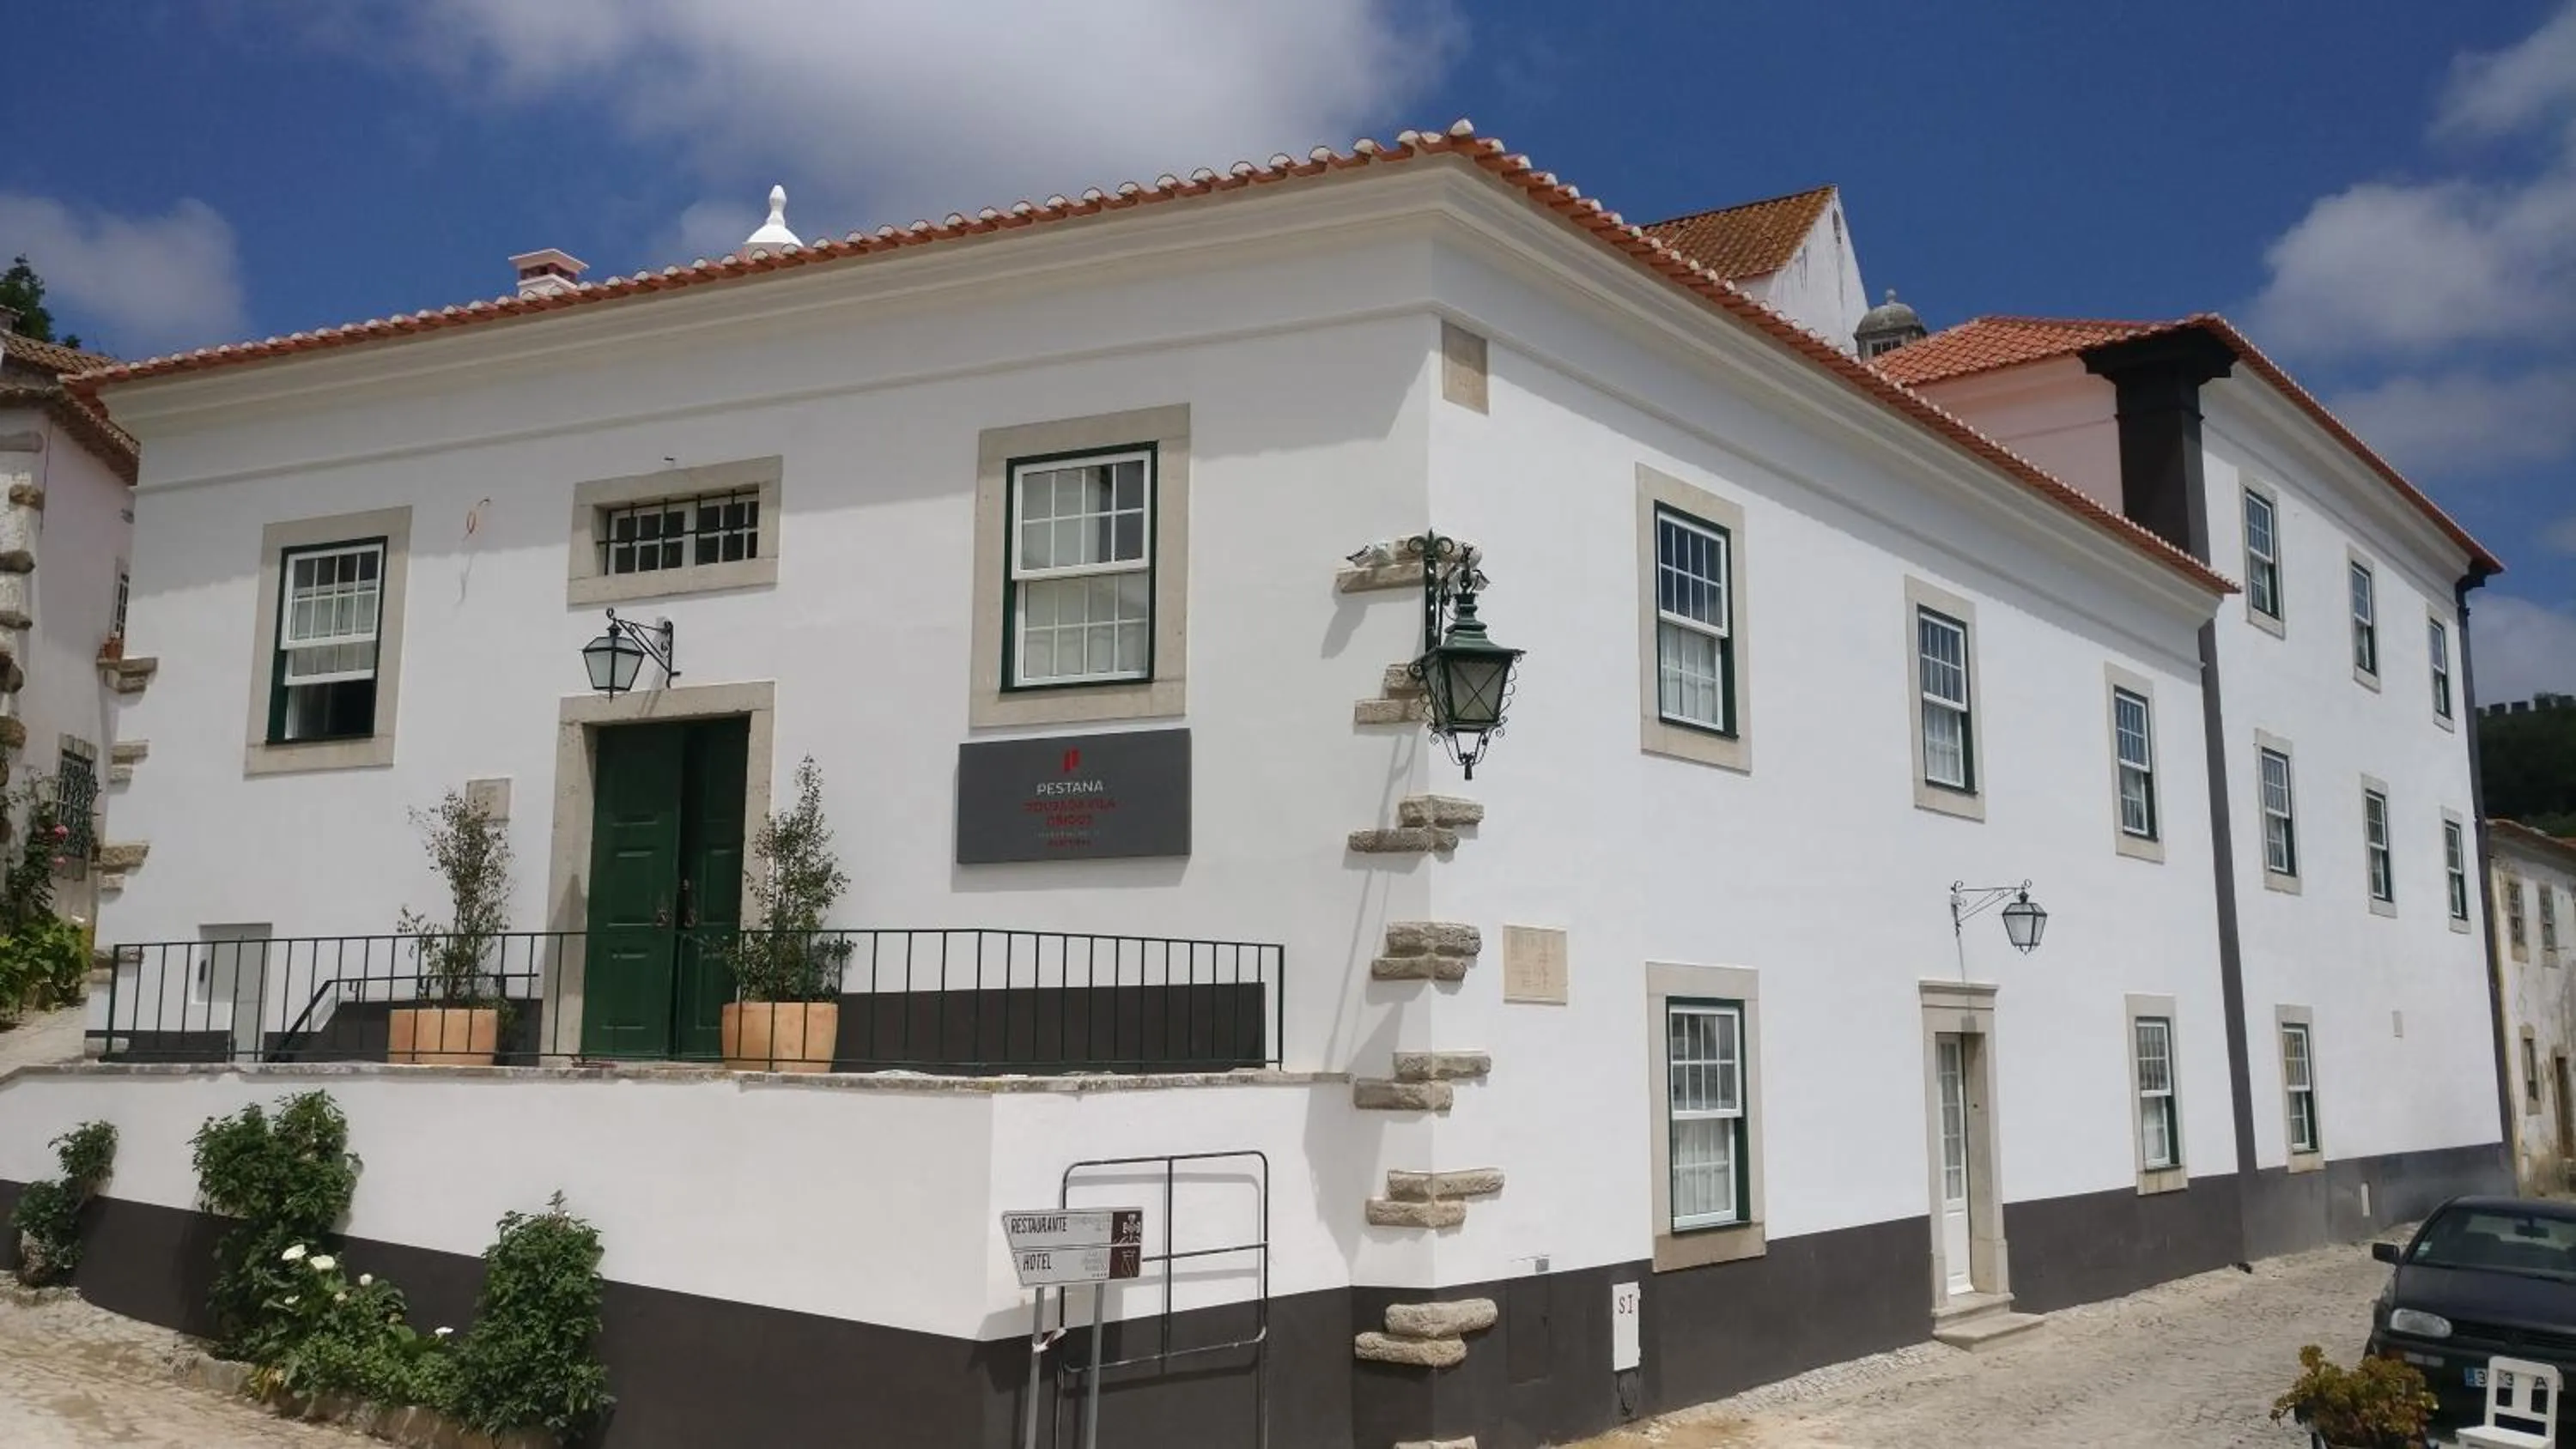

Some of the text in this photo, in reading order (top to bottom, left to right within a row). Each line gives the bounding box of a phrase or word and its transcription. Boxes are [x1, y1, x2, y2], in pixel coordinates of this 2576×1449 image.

[1036, 779, 1104, 796] PESTANA
[1011, 1216, 1068, 1234] RESTAURANTE
[1023, 1252, 1052, 1271] HOTEL
